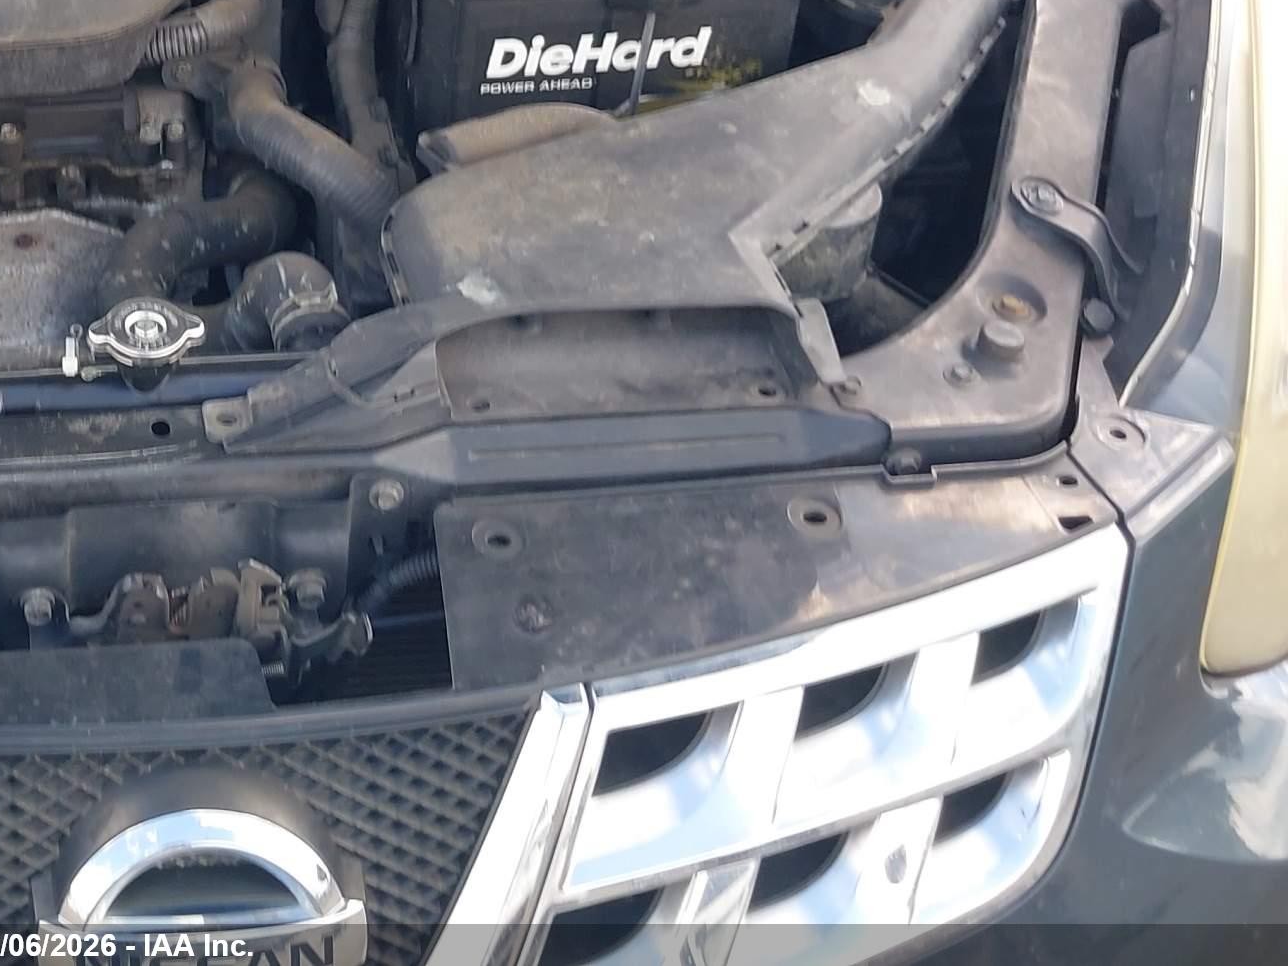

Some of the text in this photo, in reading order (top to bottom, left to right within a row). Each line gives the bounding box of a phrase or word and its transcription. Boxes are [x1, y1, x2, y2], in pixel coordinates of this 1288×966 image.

[486, 26, 712, 79] DieHard
[480, 77, 593, 95] POWER AHEAD
